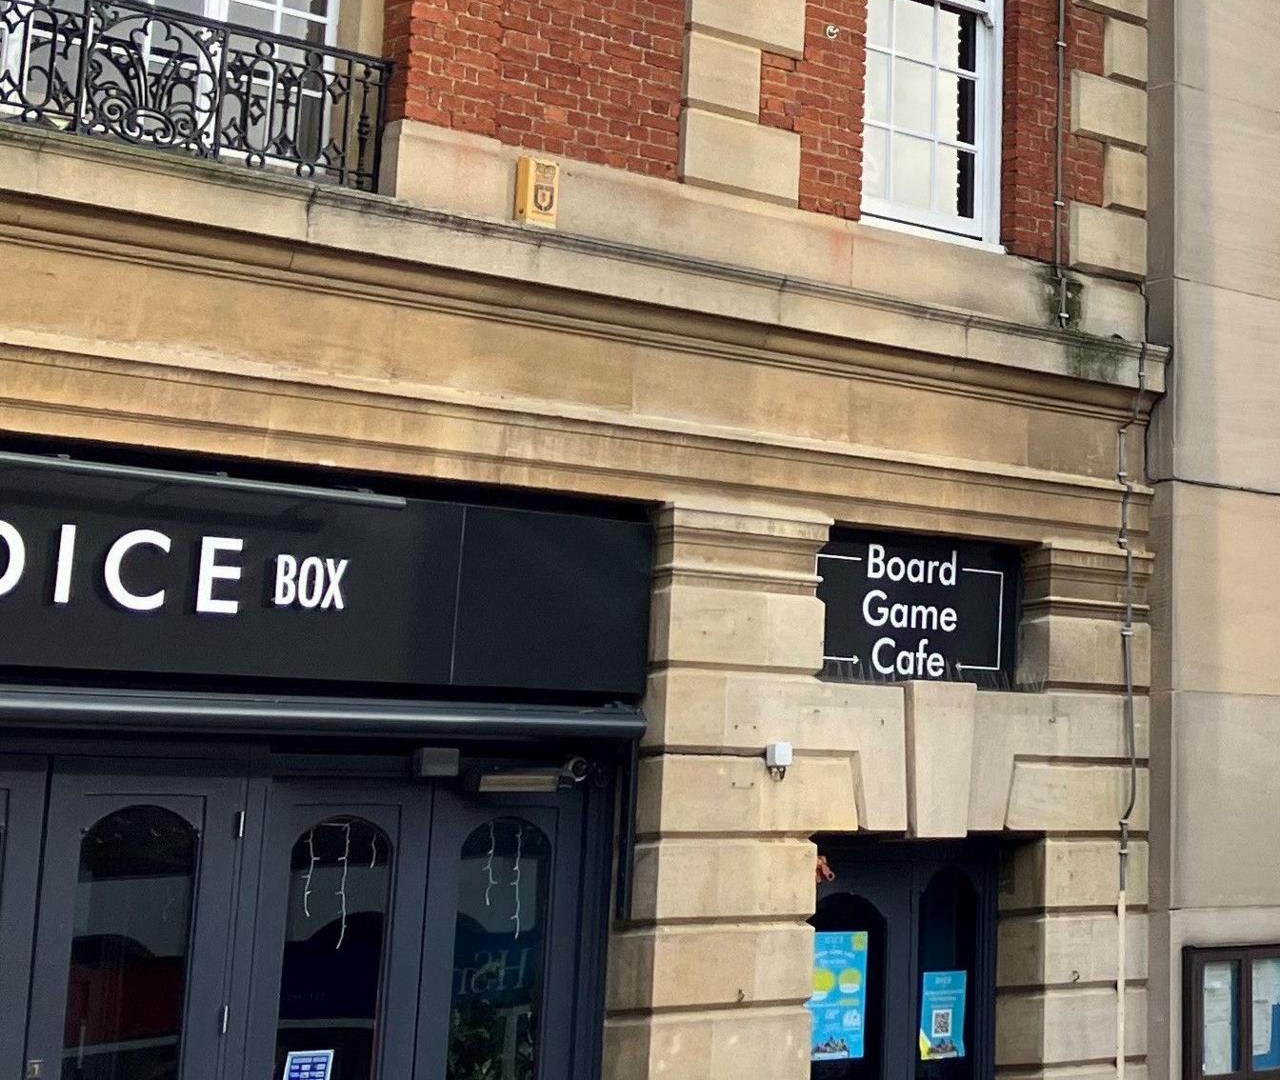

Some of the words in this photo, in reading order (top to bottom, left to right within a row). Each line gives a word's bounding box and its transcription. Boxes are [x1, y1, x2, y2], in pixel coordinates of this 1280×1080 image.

[274, 554, 349, 610] BOX
[867, 543, 957, 586] Board
[862, 589, 957, 632] Game
[871, 637, 945, 677] Cafe
